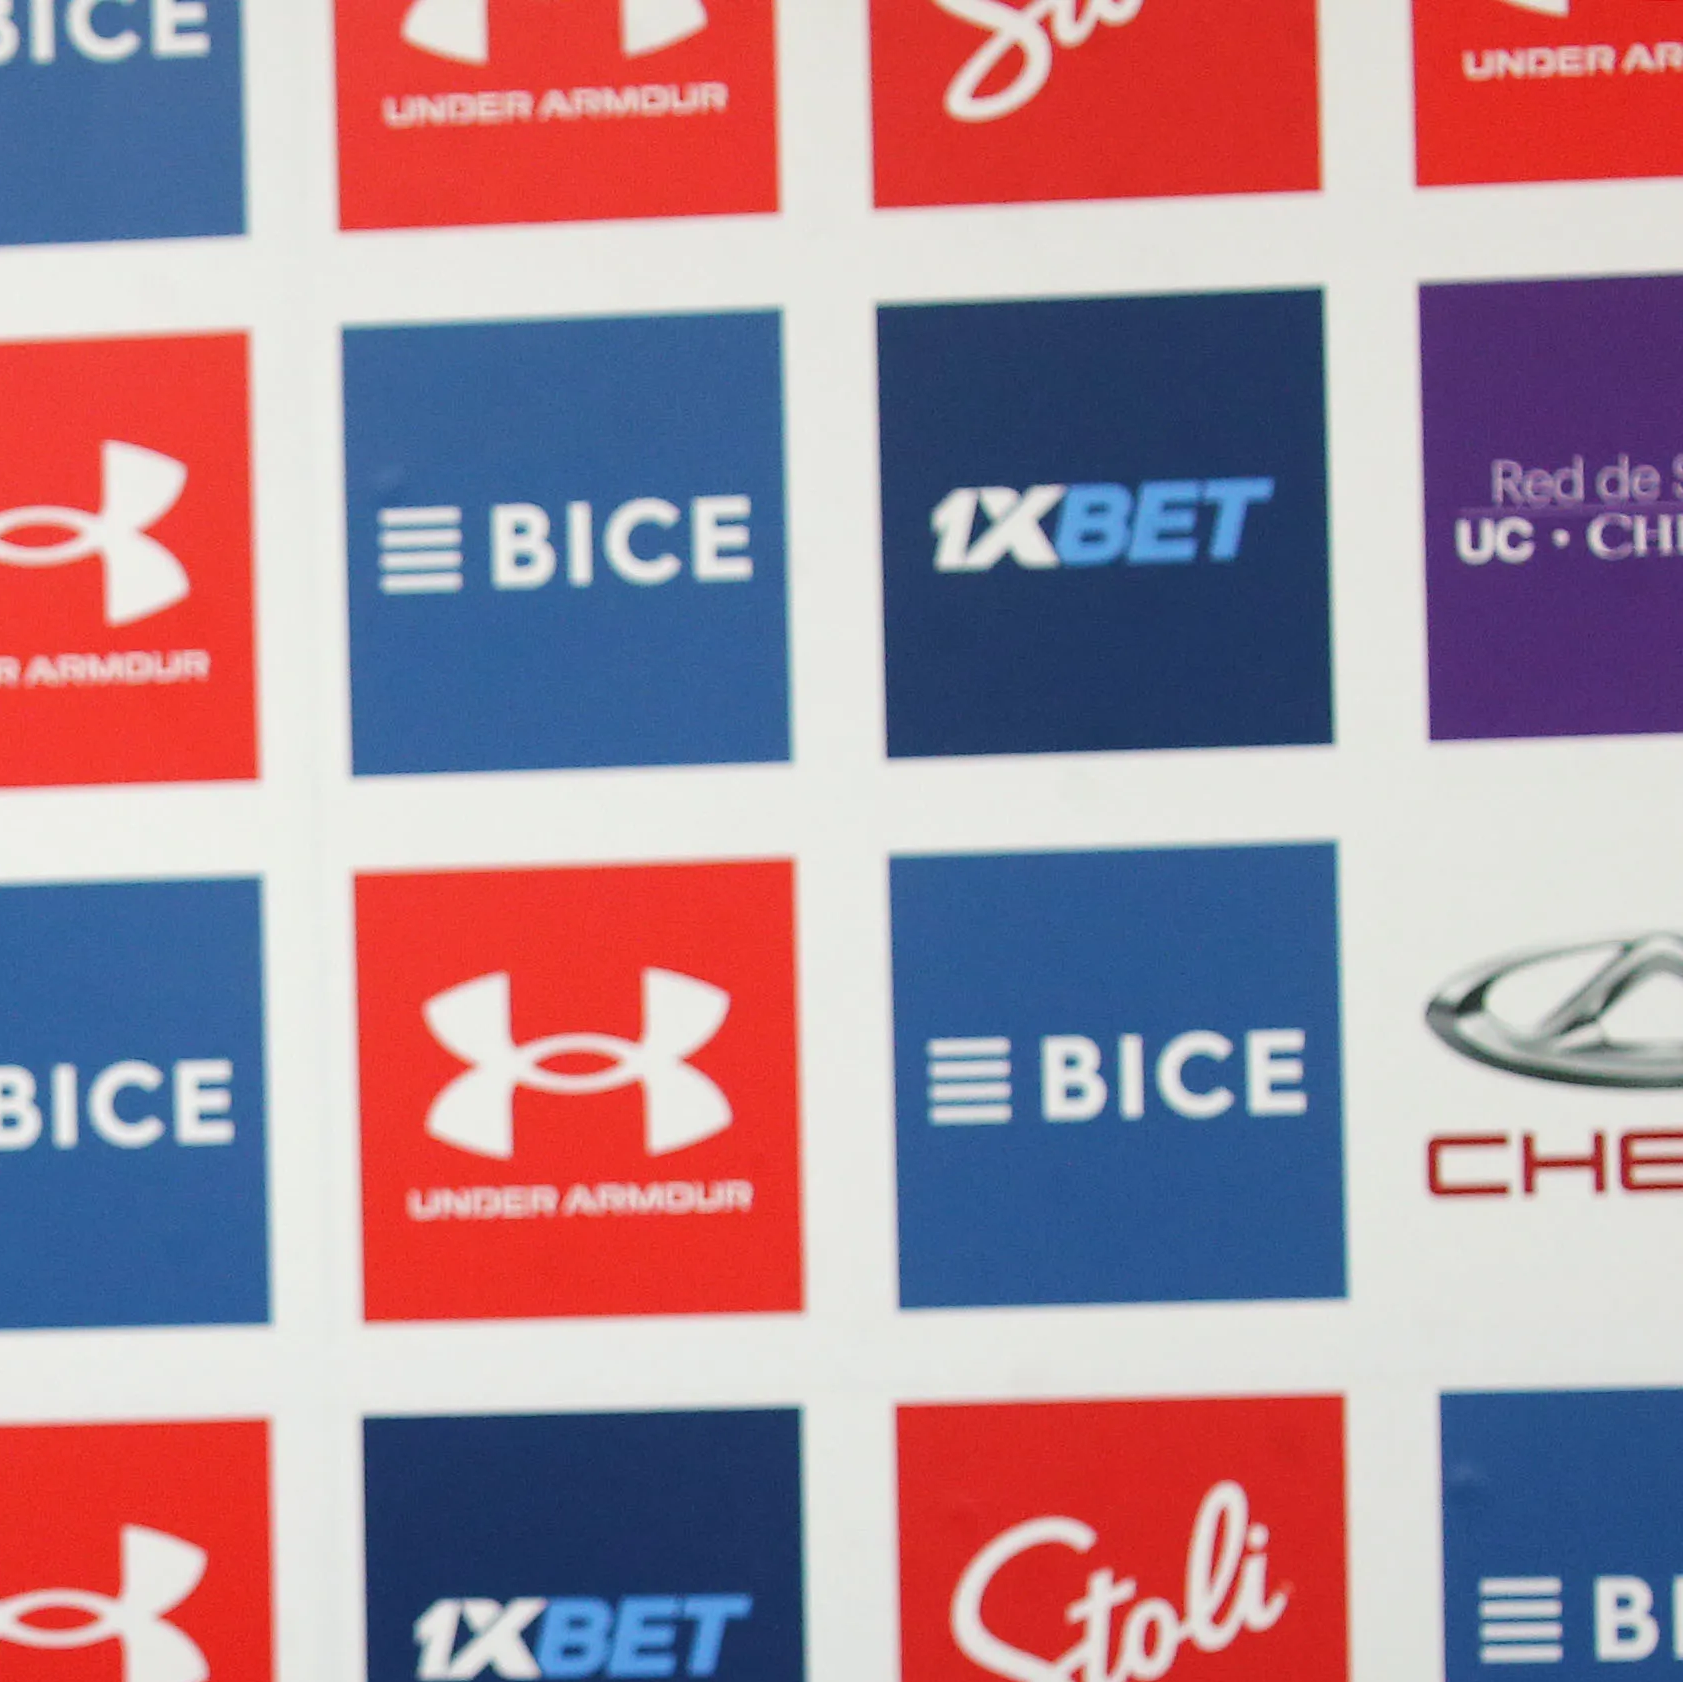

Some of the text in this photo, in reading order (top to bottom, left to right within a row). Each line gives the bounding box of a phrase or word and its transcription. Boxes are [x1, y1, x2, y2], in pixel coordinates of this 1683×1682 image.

[1463, 44, 1617, 80] UNDER
[383, 82, 729, 127] UNDER ARMOUR
[1492, 455, 1585, 503] Red
[1595, 452, 1661, 501] de
[490, 495, 753, 590] BICE
[929, 478, 1273, 573] 1XBET
[1455, 517, 1534, 565] UC
[23, 650, 211, 686] ARMOUR
[1040, 1029, 1307, 1122] BICE
[407, 1180, 754, 1220] UNDER ARMOUR
[413, 1595, 751, 1682] 1XBET
